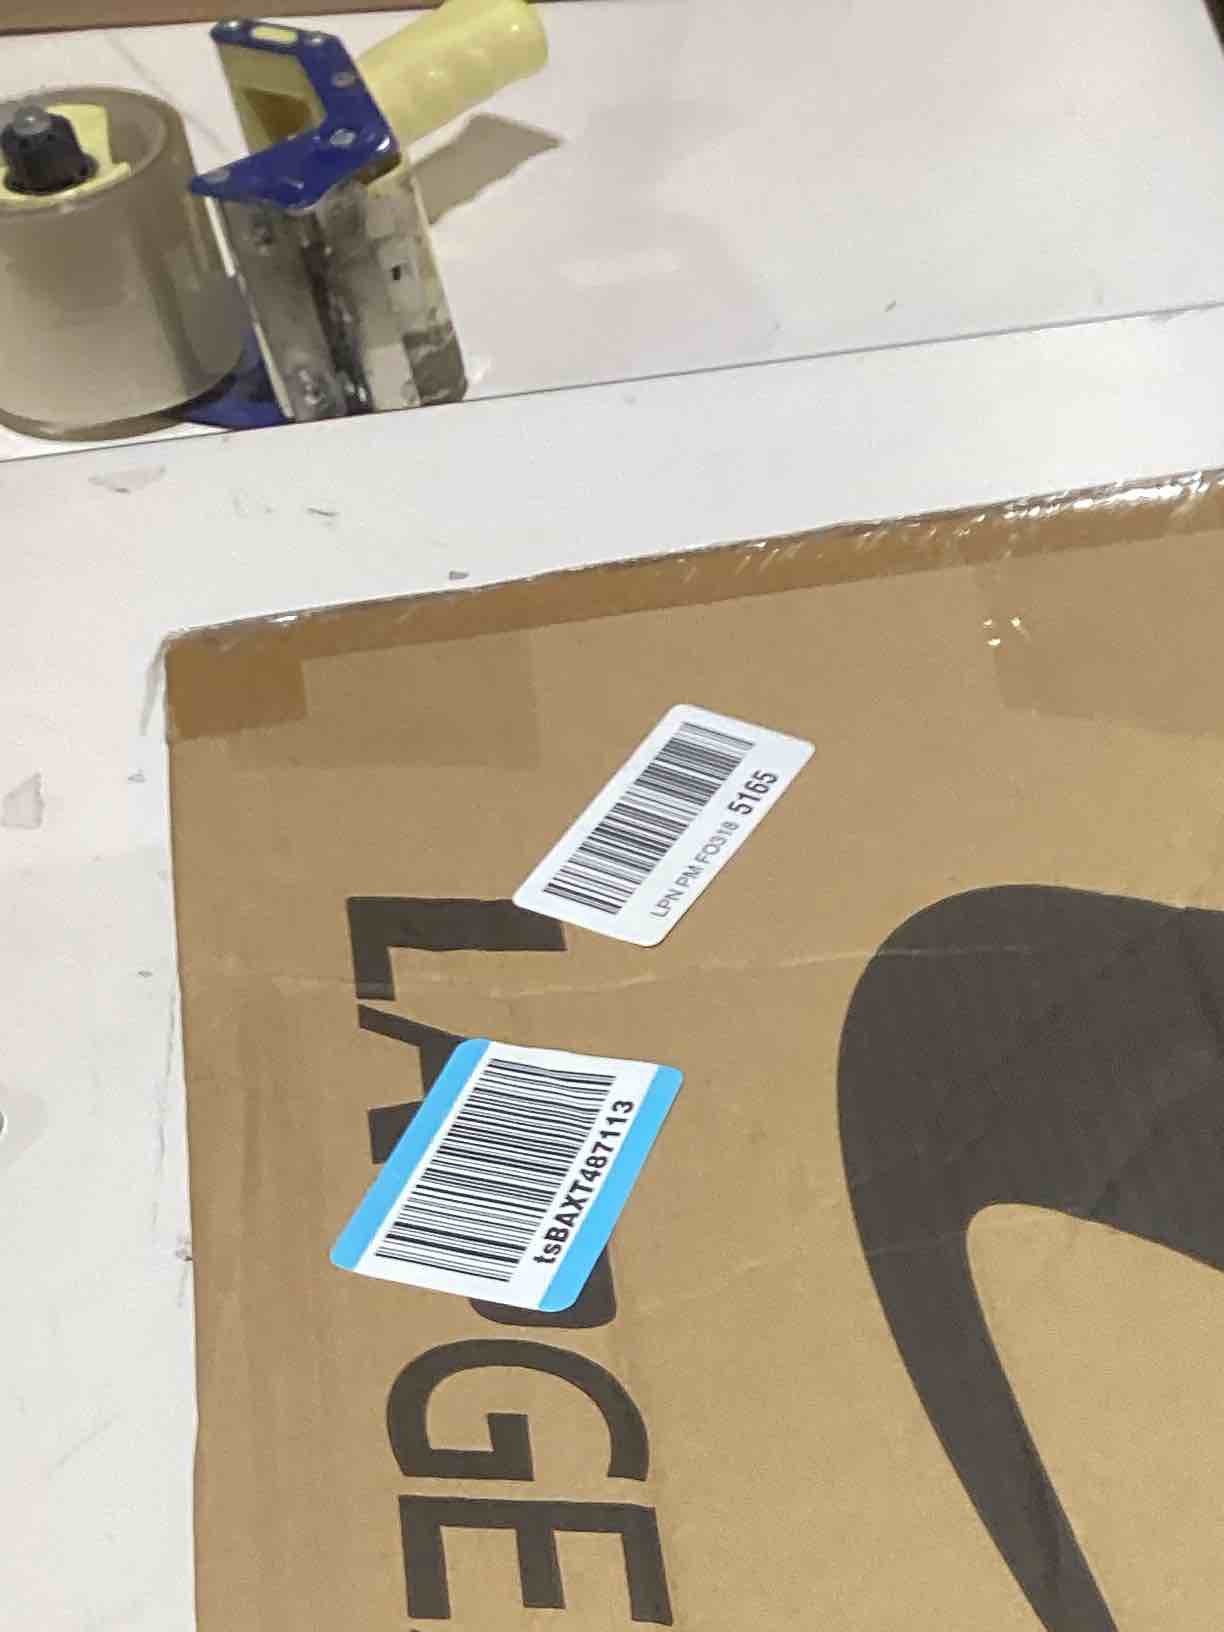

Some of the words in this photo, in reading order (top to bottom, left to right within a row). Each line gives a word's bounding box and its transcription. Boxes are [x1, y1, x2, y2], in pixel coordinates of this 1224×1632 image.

[651, 888, 683, 918] LPN
[676, 864, 705, 889] PM
[728, 769, 778, 815] 5165
[534, 1100, 635, 1264] tsBAXT487113
